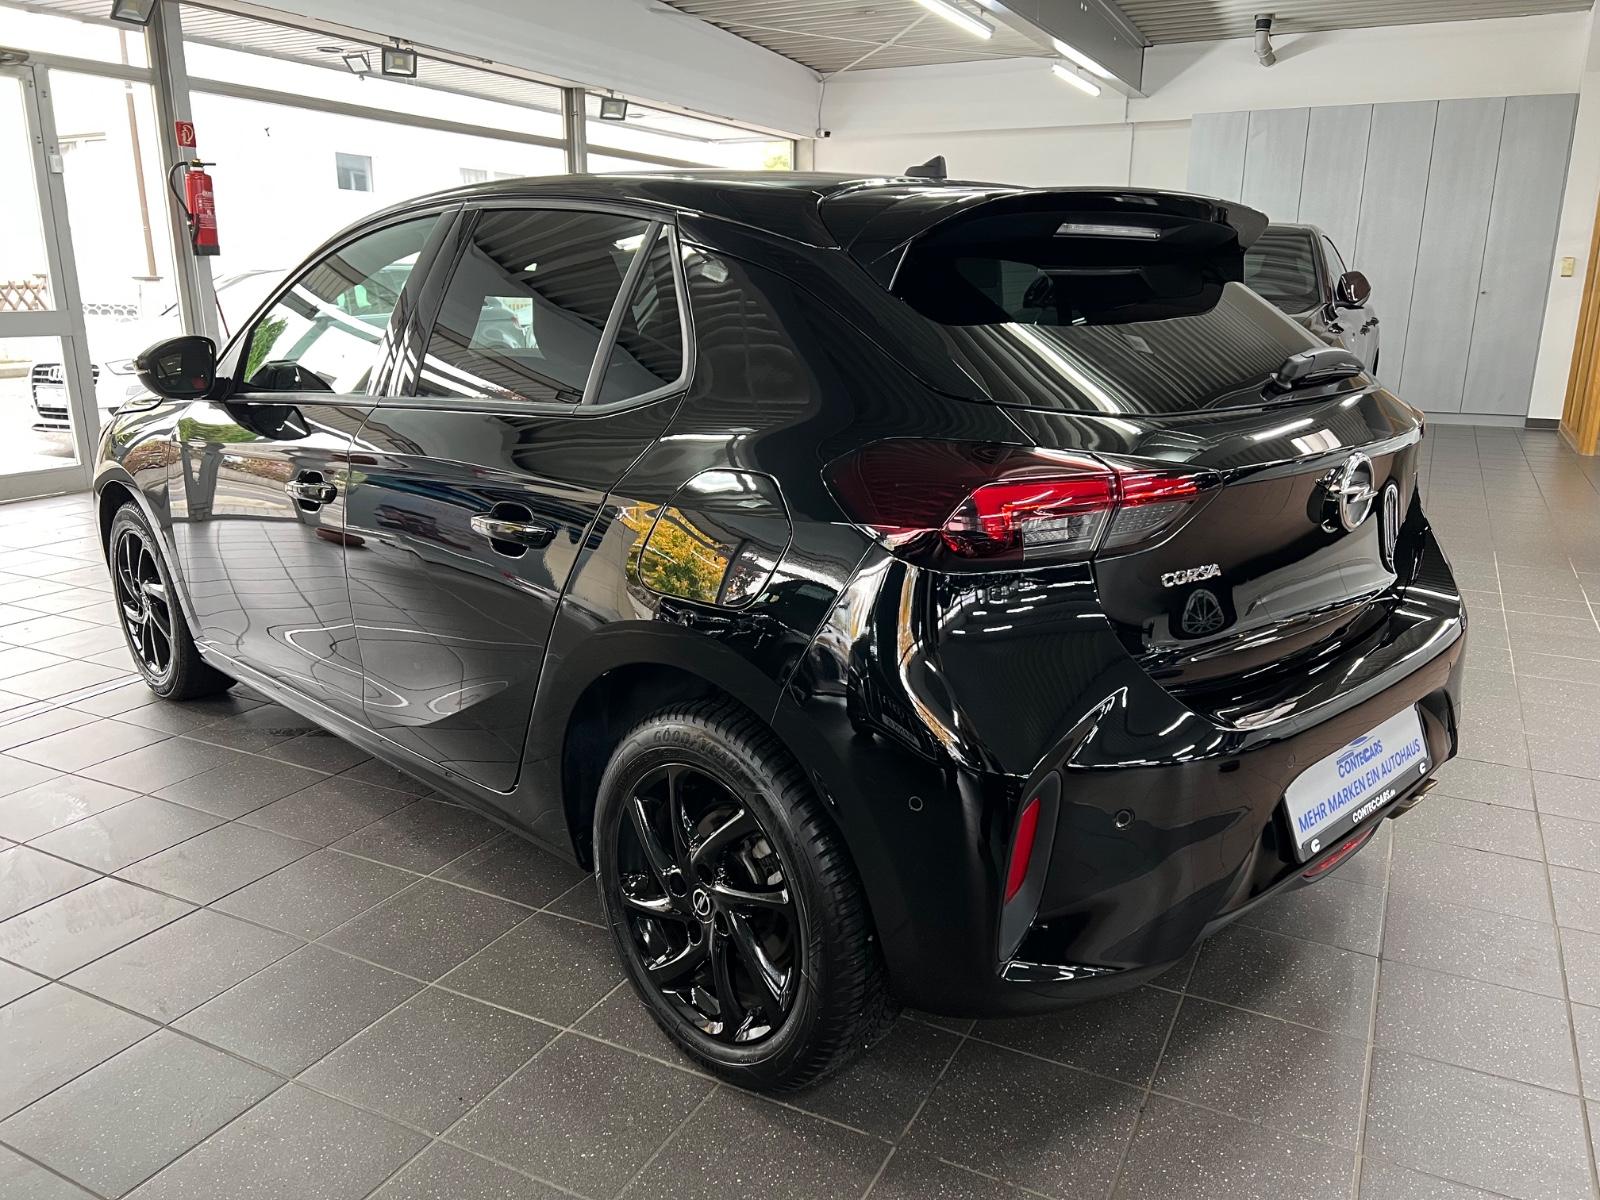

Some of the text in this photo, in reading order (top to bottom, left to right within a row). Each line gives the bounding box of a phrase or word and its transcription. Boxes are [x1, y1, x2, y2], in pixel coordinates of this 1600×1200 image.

[1160, 563, 1222, 588] CORSA
[1298, 803, 1328, 833] MEHR
[1327, 778, 1367, 813] MARKEN
[1367, 768, 1381, 789] EIN
[1381, 738, 1421, 779] AUTOHAUS
